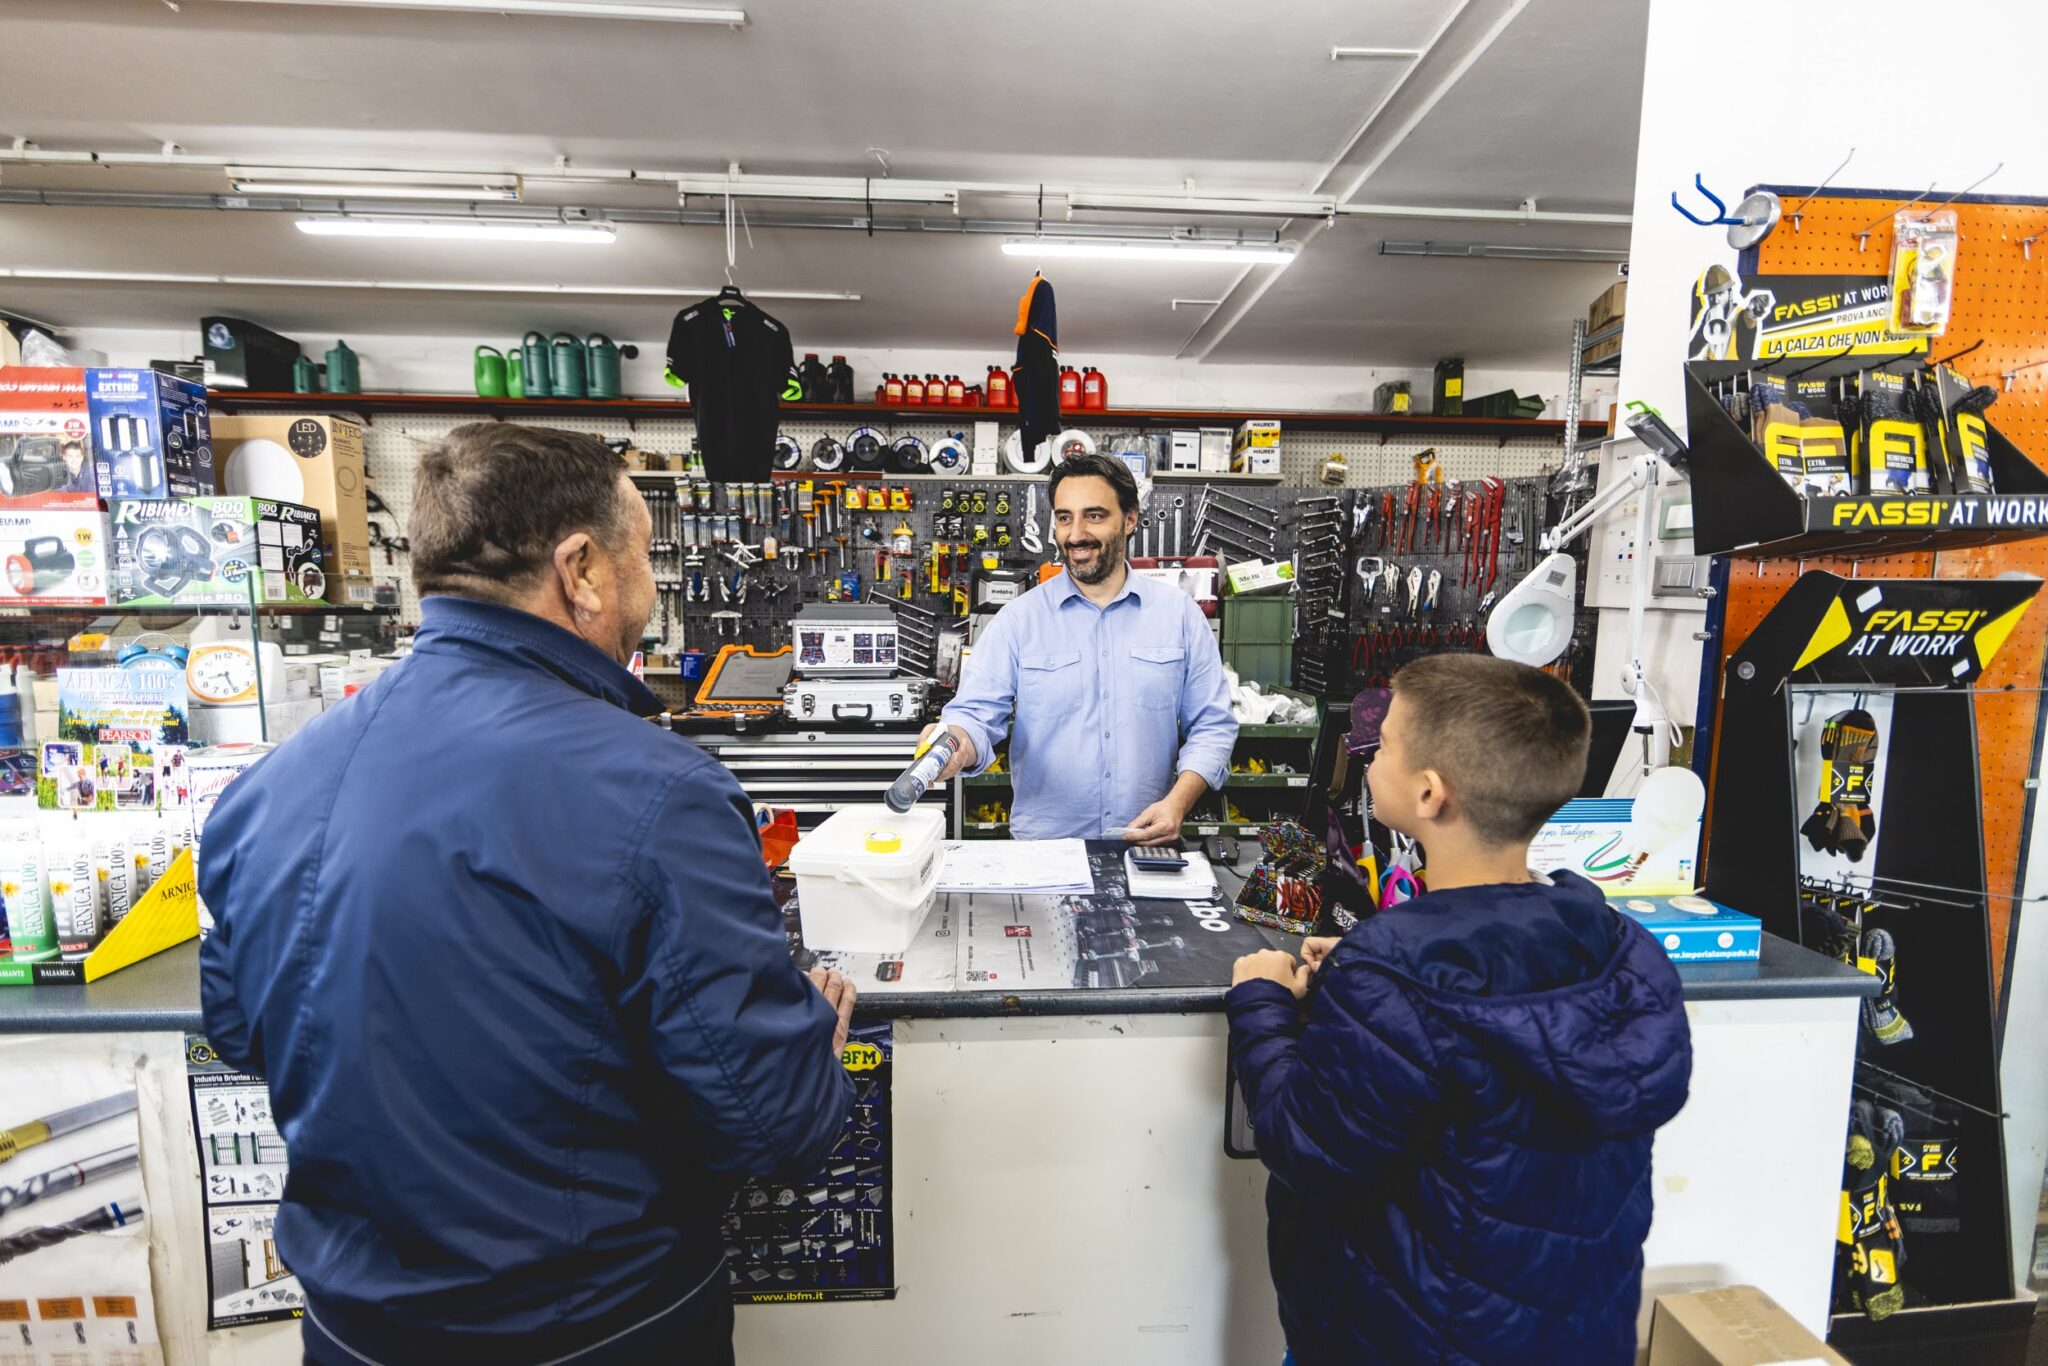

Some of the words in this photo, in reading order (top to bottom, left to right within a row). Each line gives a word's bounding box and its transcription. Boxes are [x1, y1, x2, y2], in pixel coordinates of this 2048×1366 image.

[1774, 295, 1840, 322] FASSI
[1844, 291, 1857, 305] AT
[1861, 285, 1888, 301] WOR
[1836, 311, 1864, 324] PROVA
[1866, 307, 1888, 319] ANC
[1768, 340, 1783, 354] LA
[1786, 335, 1825, 353] CALZA
[1832, 332, 1851, 348] CHE
[1854, 330, 1881, 345] NON
[1872, 372, 1904, 384] FASSI
[295, 422, 317, 433] LED
[211, 501, 246, 514] 800
[257, 503, 278, 513] 800
[279, 506, 318, 523] RIBIMEX
[1832, 501, 1944, 526] FASSI
[1949, 500, 1979, 525] AT
[1863, 610, 1984, 632] FASSI
[1848, 635, 1886, 656] AT
[1888, 635, 1965, 656] WORK
[65, 671, 132, 690] ARNICA
[101, 730, 151, 740] PEARSON
[160, 879, 196, 902] ARNIC
[74, 885, 94, 935] ARNICA
[841, 1050, 877, 1065] BFM
[194, 1075, 223, 1083] Industria
[224, 1074, 251, 1082] Briantea
[1921, 1153, 1942, 1171] F
[752, 1291, 824, 1302] www.ibfm.it
